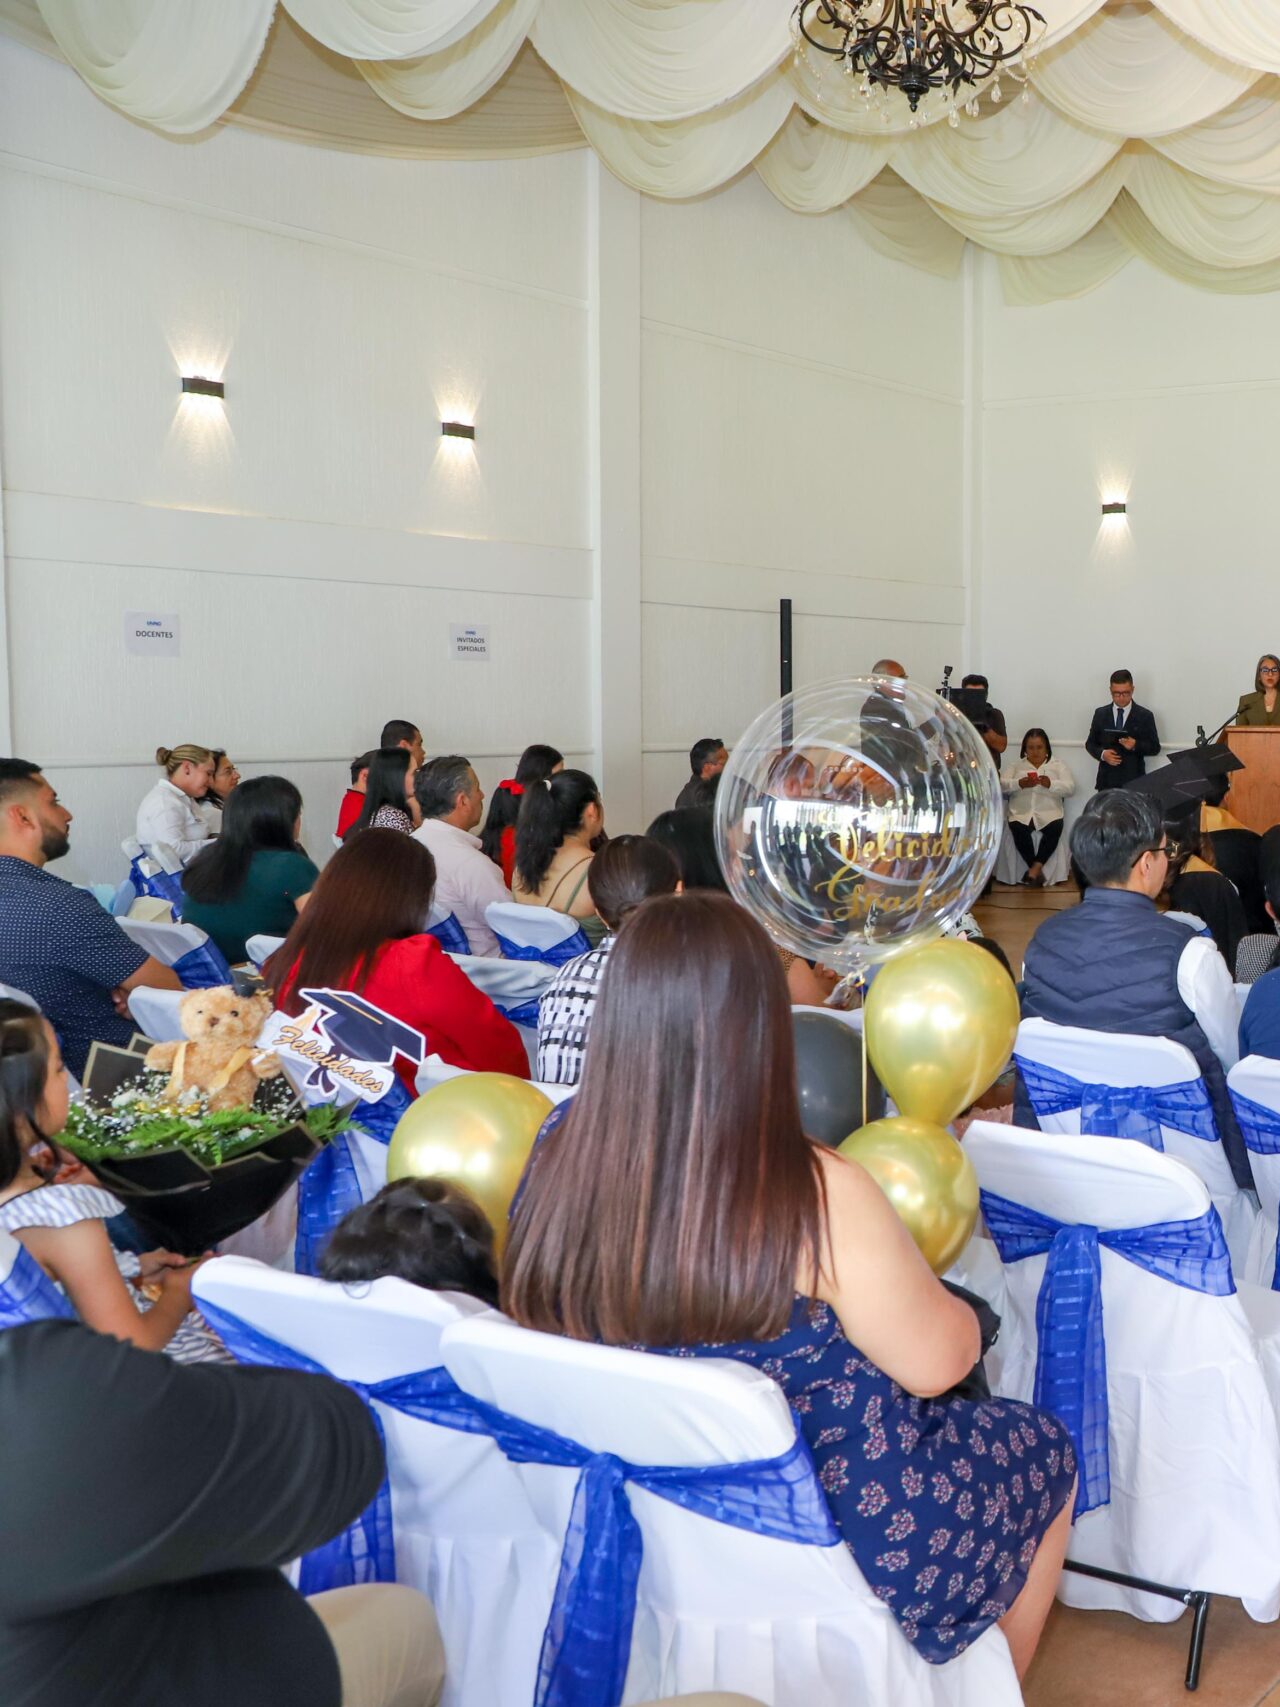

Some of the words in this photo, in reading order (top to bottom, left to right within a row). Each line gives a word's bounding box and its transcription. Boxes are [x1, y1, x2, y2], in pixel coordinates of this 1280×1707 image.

[135, 630, 174, 639] DOCENTES
[457, 645, 486, 653] ESPECIALES
[271, 1025, 384, 1094] Felicidades
